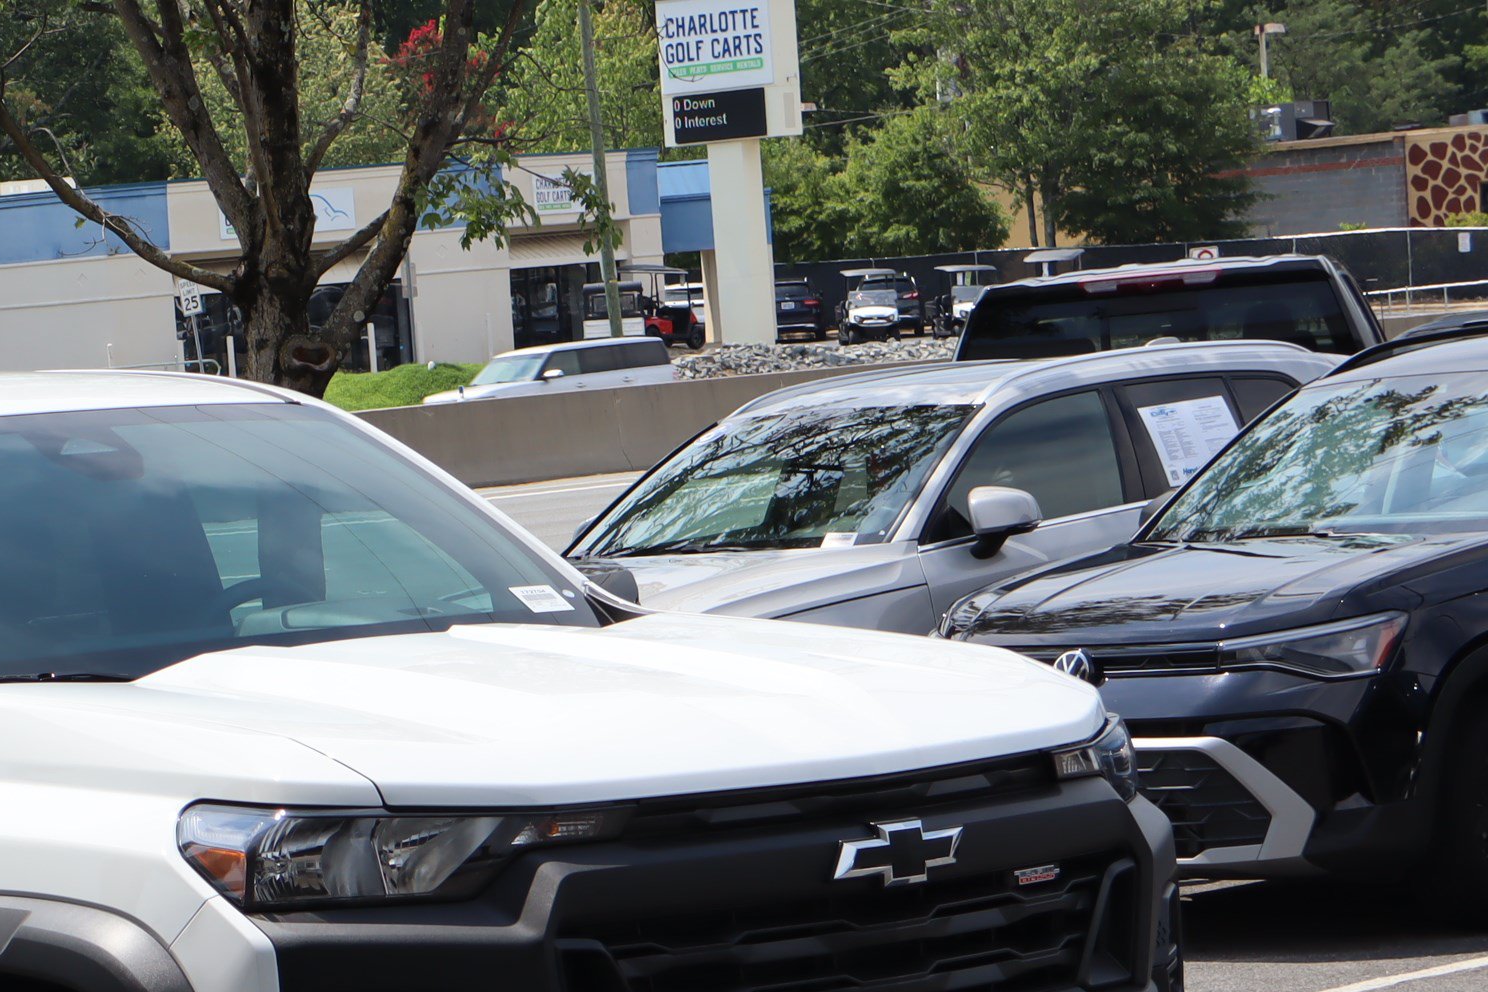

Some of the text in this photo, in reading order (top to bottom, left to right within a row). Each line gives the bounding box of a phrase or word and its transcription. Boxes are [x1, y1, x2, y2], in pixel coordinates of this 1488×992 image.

[665, 8, 760, 39] CHARLOTTE
[665, 33, 764, 64] GOLF CARTS
[674, 99, 716, 112] 0 Down
[675, 113, 728, 129] 0 Interest
[184, 295, 199, 311] 25
